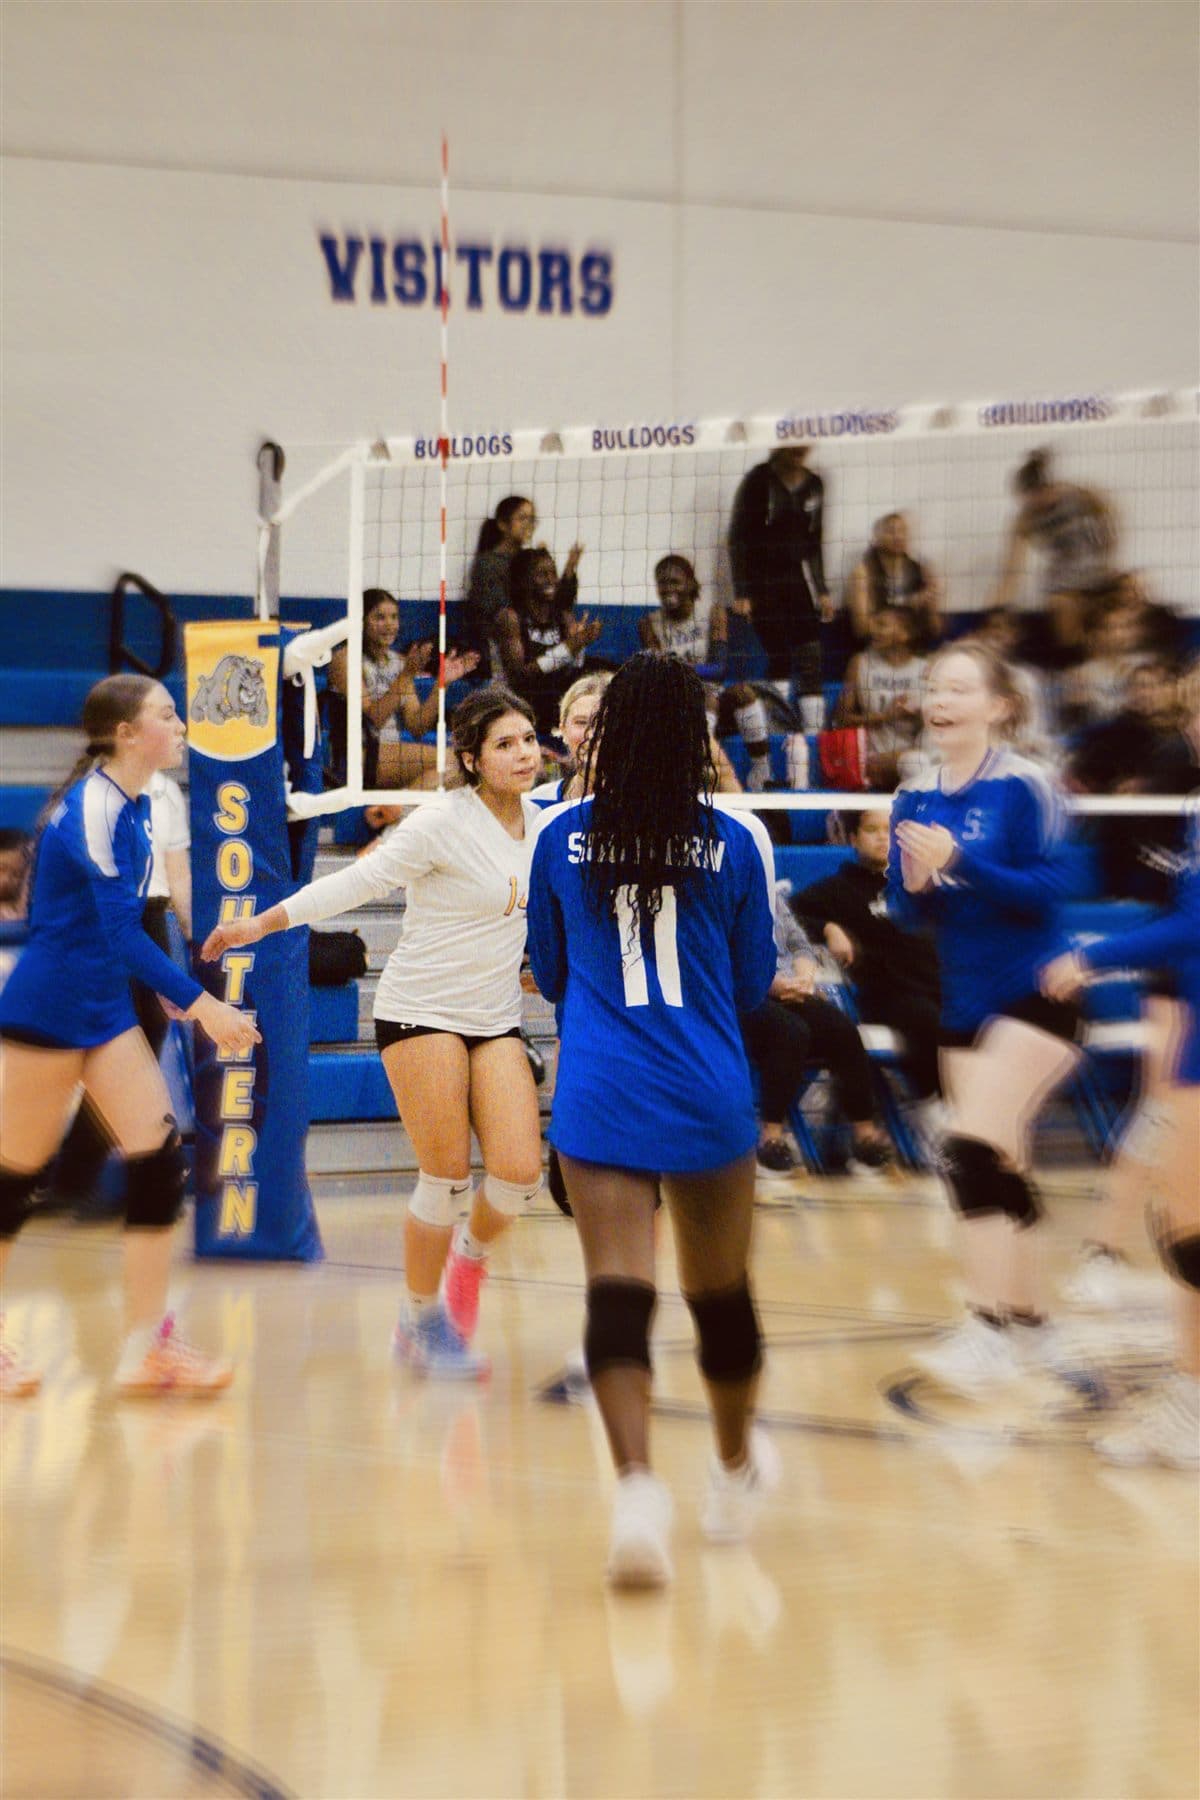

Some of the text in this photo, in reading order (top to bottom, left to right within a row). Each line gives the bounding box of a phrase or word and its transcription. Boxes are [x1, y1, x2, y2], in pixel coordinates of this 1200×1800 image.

[414, 434, 514, 459] BULDOGS
[592, 424, 695, 450] BULLDOGS
[611, 883, 684, 1008] 11
